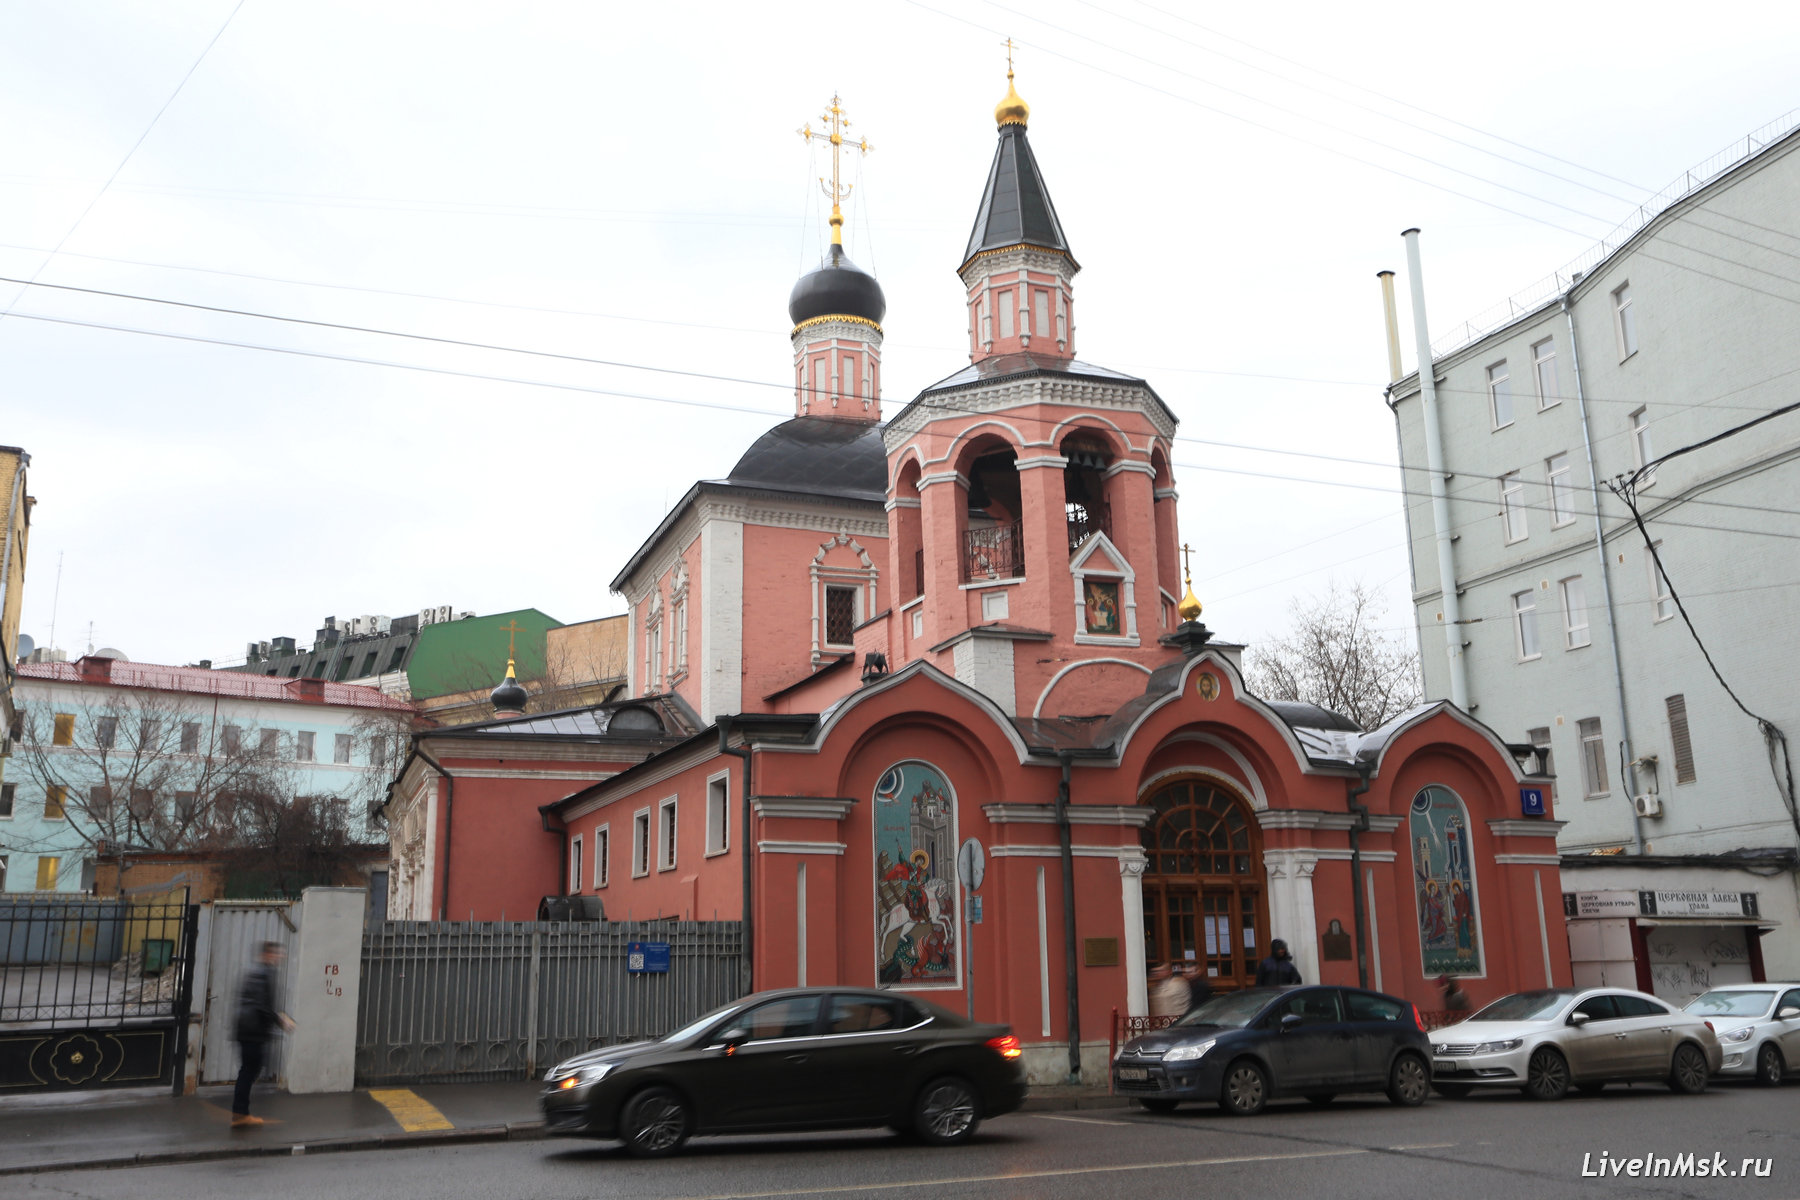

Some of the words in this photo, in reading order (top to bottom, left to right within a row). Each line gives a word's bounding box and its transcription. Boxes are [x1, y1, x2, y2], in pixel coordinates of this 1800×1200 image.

[1530, 793, 1537, 806] 9
[1658, 893, 1708, 903] ЦЕРКОВНАЯ
[1712, 894, 1739, 903] ЛАВКА
